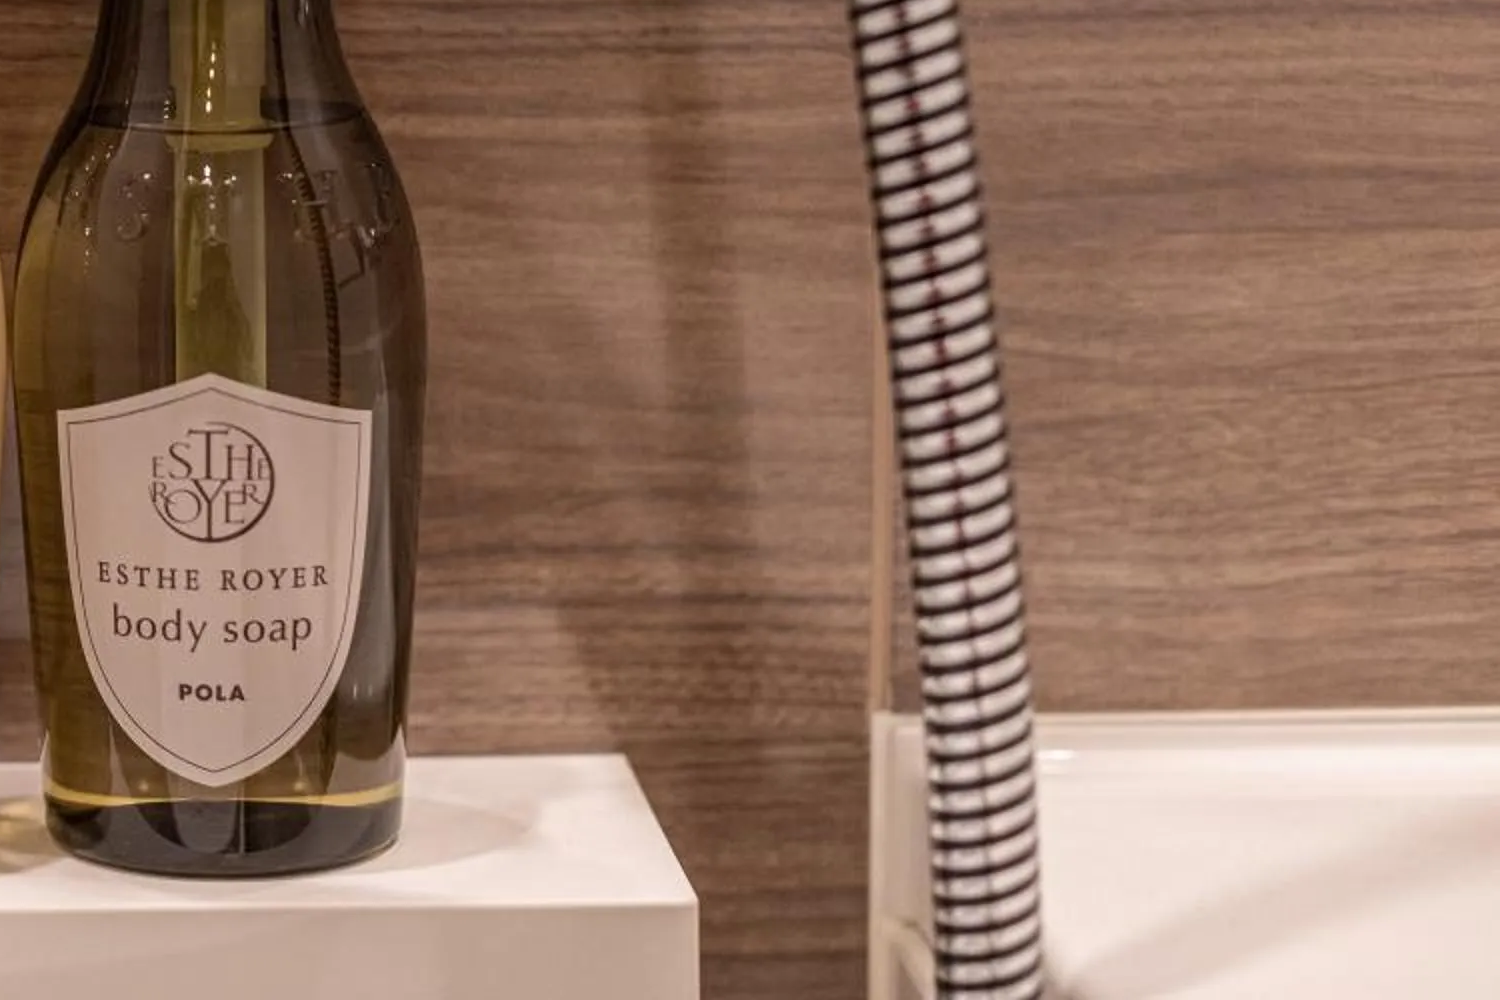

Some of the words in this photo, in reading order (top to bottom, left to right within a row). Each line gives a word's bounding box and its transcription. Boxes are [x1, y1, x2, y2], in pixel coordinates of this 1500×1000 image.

[97, 560, 200, 591] ESTHE
[219, 564, 329, 592] ROYER
[112, 602, 207, 653] body
[222, 613, 313, 651] soap
[176, 682, 247, 703] POLA
